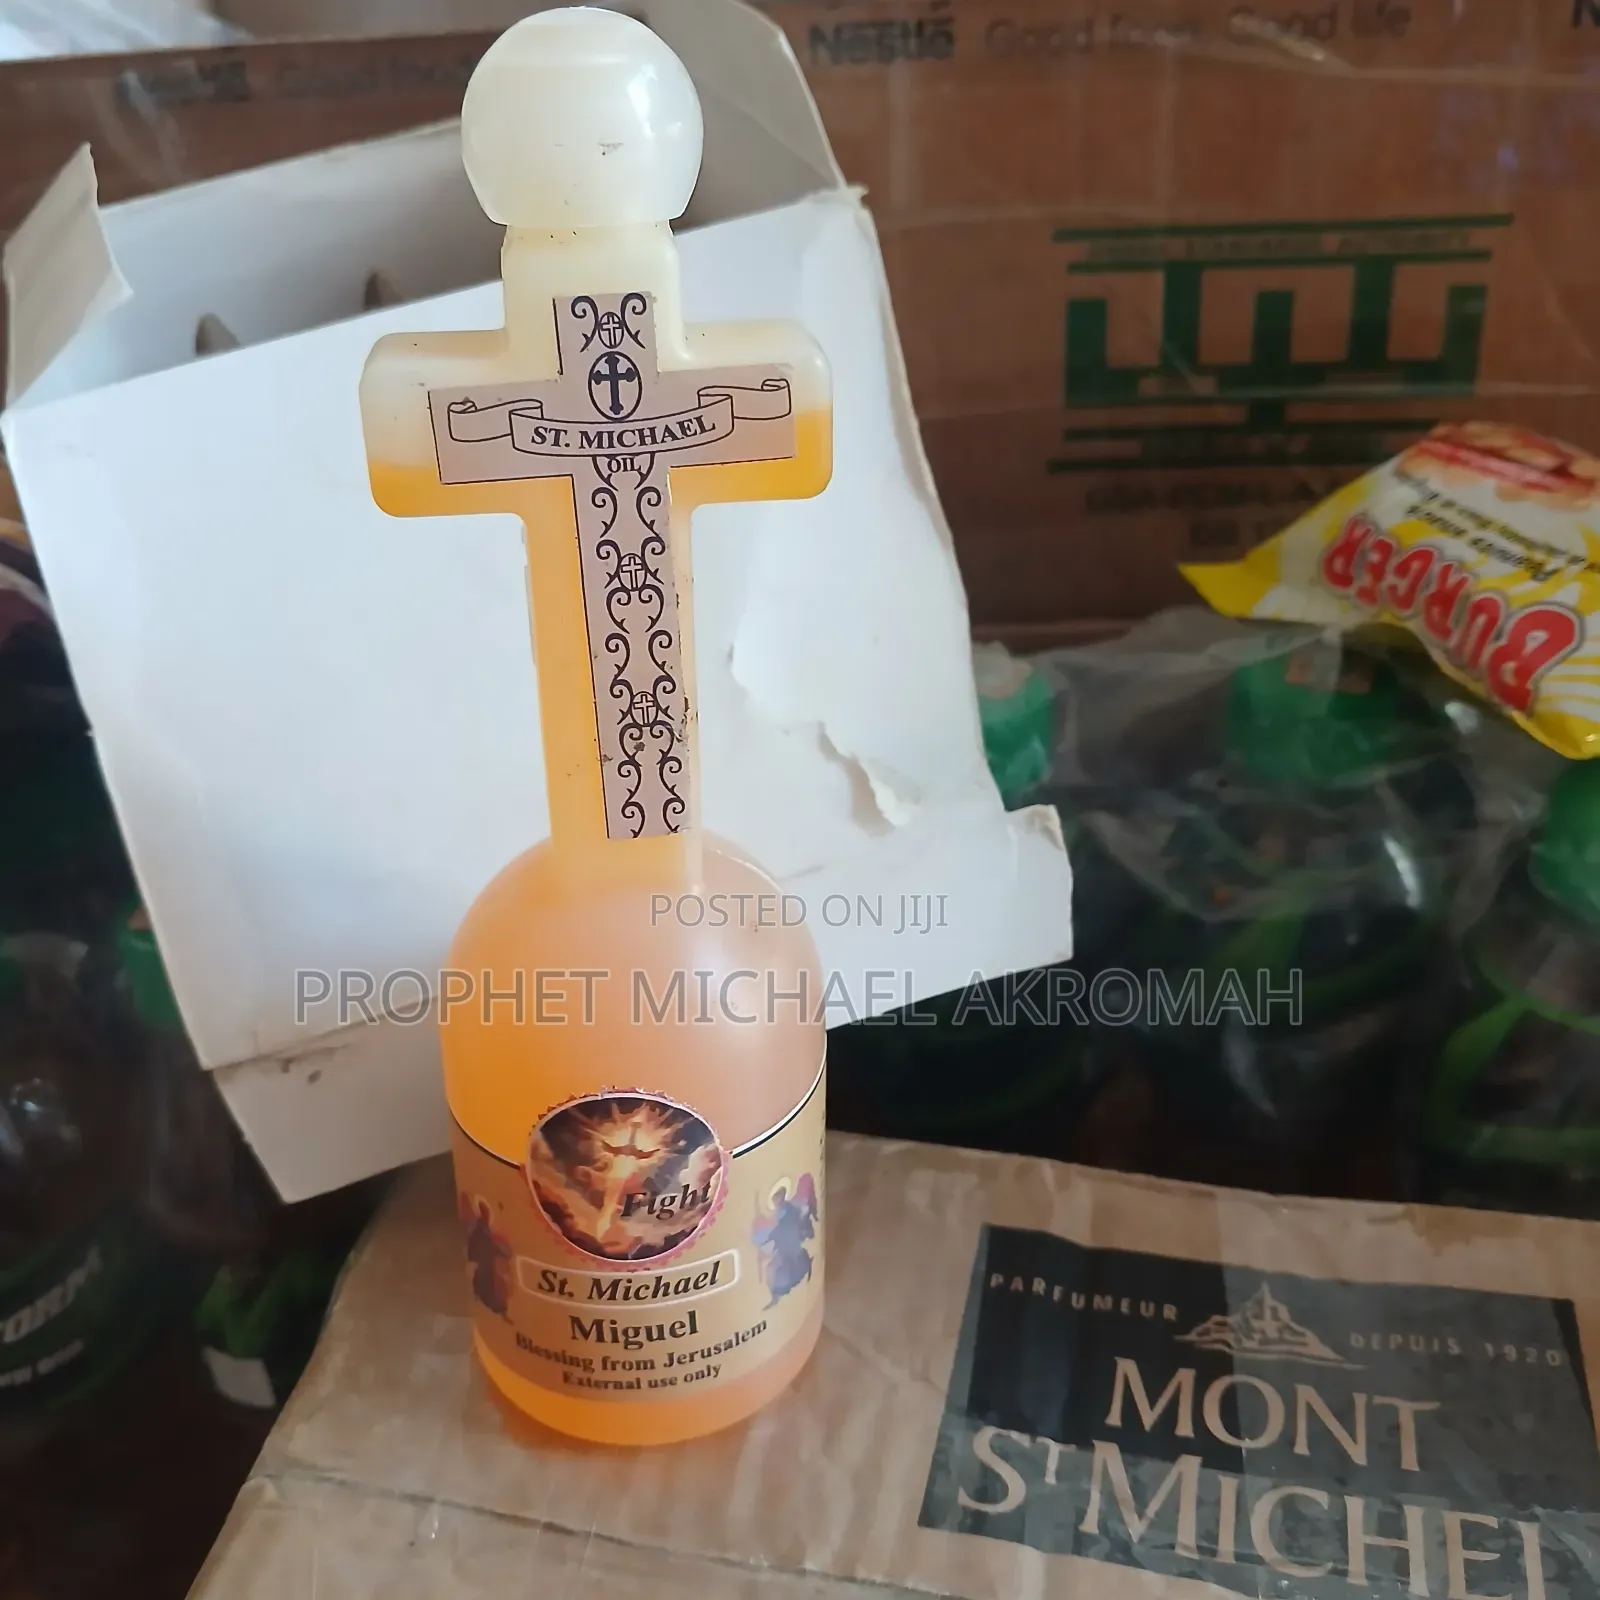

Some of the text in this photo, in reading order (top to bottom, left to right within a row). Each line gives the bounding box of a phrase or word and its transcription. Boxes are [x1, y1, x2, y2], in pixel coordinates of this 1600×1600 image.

[531, 413, 717, 451] ST. MICHAEL
[606, 455, 642, 474] OIL
[1320, 513, 1582, 716] BURGER
[620, 1180, 714, 1221] Fight
[537, 1260, 721, 1301] St. Michael
[568, 1310, 700, 1350] Miguel
[989, 1272, 1562, 1367] PARFUMEUR DEPUIS 1920
[515, 1319, 768, 1374] Blessing from Jerusalem
[561, 1362, 723, 1390] External use only
[1105, 1356, 1441, 1472] MONT
